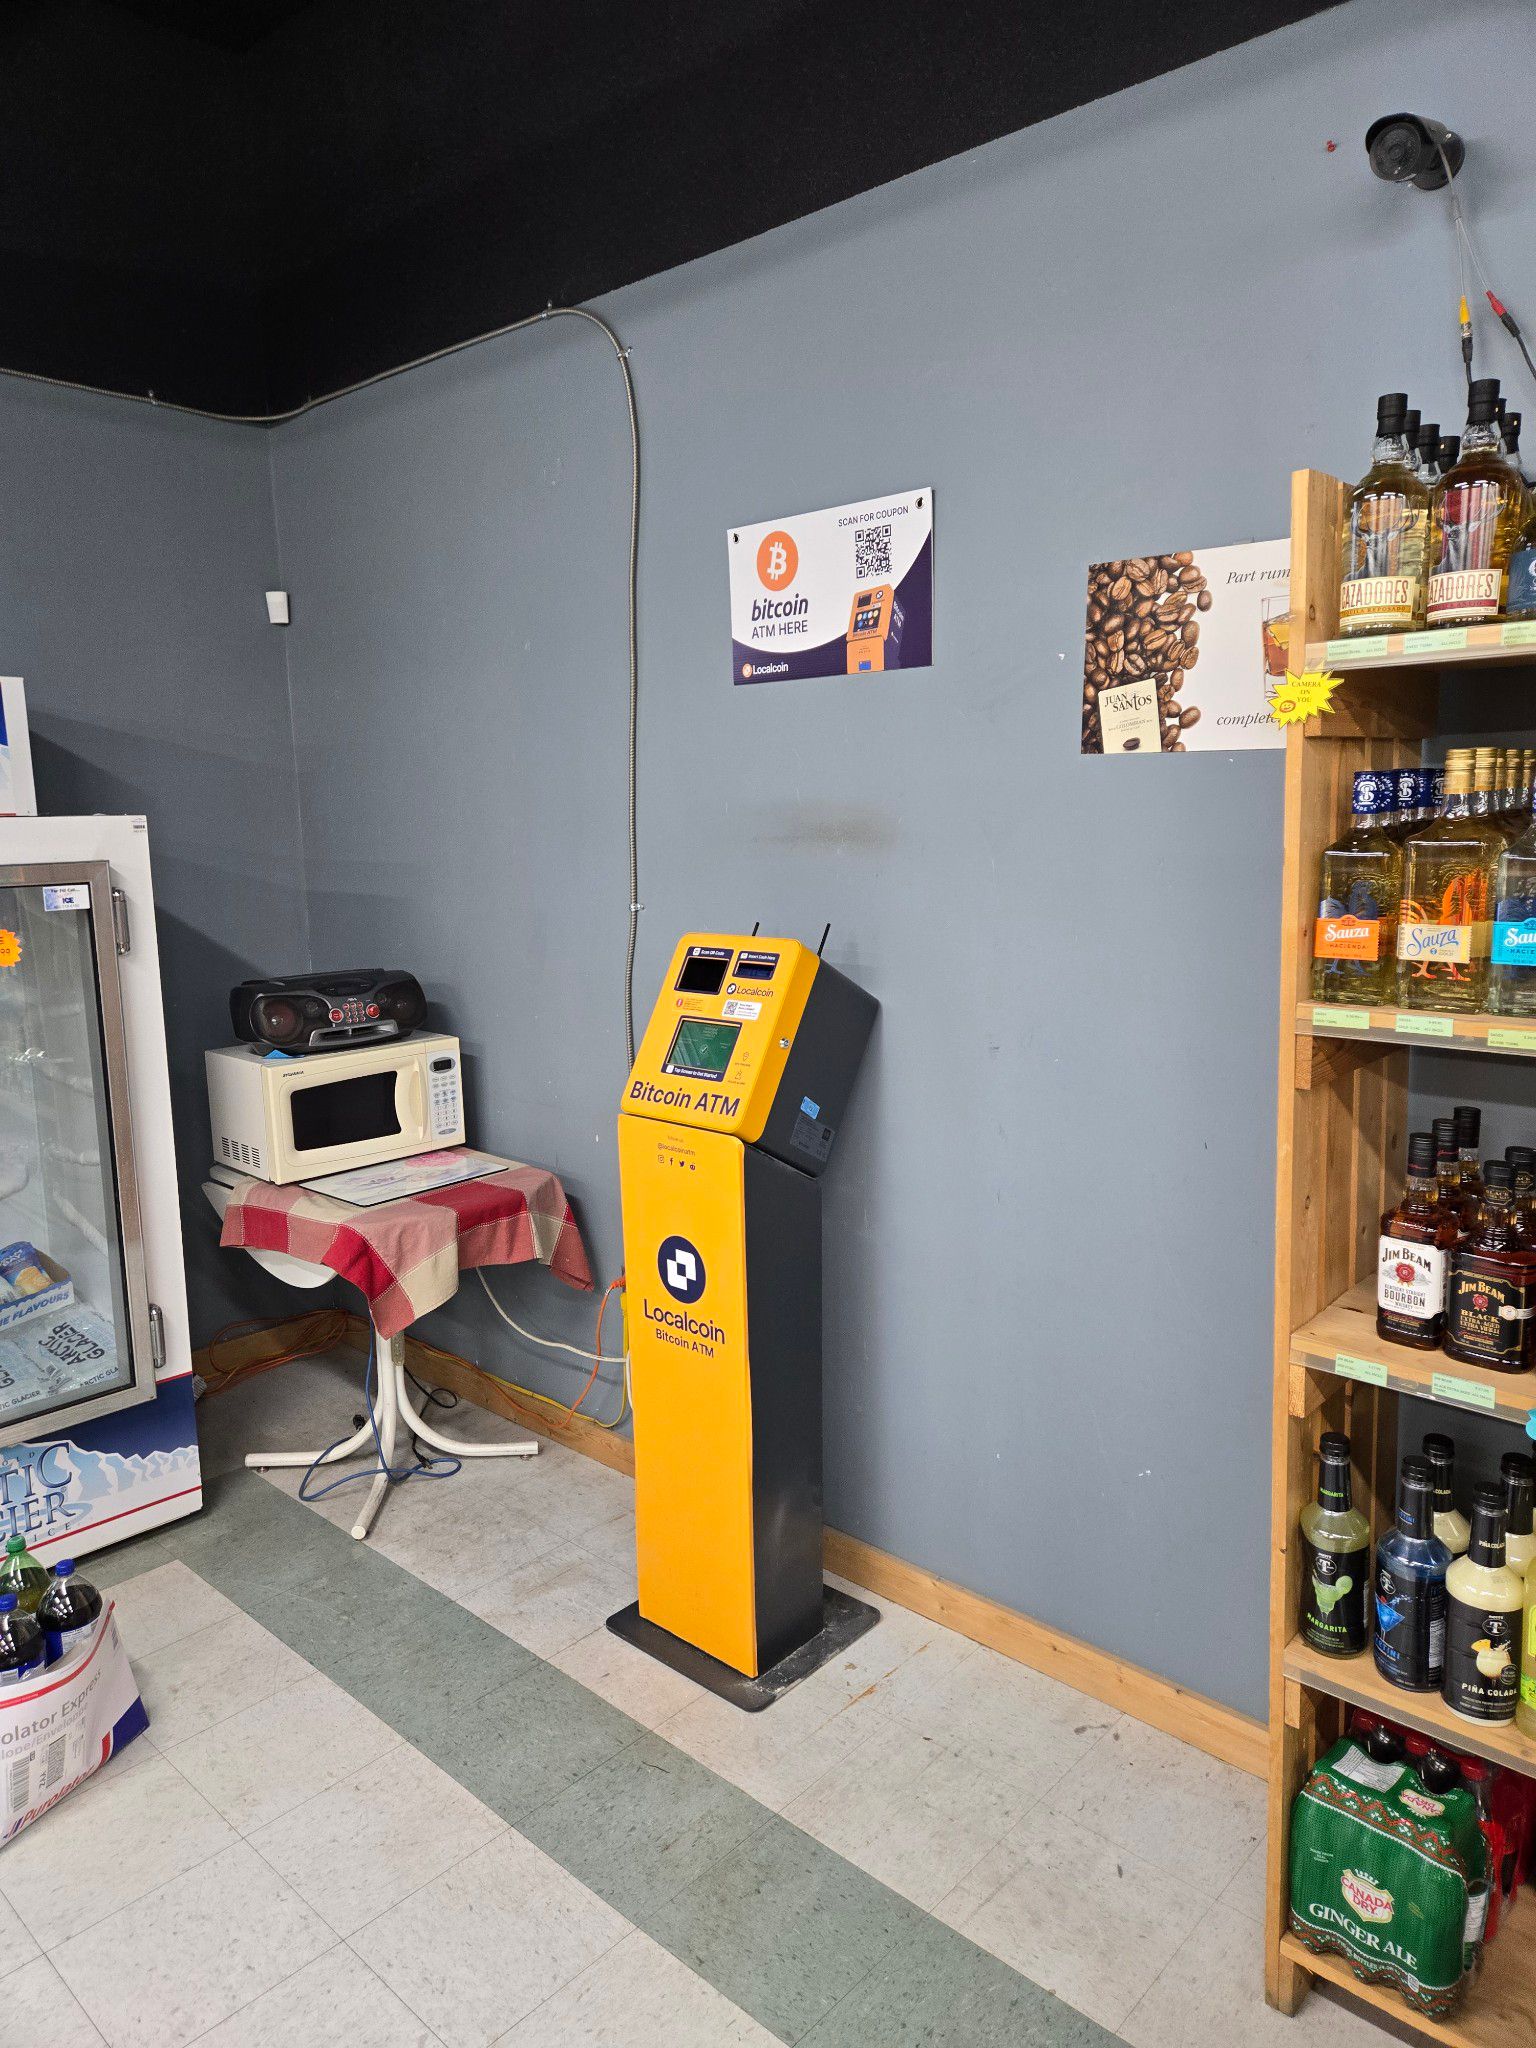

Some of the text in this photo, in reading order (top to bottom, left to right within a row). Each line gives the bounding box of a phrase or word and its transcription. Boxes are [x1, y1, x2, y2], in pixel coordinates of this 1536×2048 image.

[838, 505, 909, 527] SCAN FOR COUPON
[1226, 568, 1291, 585] Part rum
[1428, 573, 1494, 604] AZADORES
[1341, 579, 1409, 610] CAZADORES
[751, 593, 809, 622] bitcoin
[751, 619, 809, 640] ATM HERE
[752, 662, 789, 676] Localcoin
[1104, 693, 1128, 708] JUAN
[62, 896, 75, 904] ICE
[1325, 923, 1370, 942] Sauza
[1406, 927, 1460, 957] Sauza
[736, 985, 774, 998] Localcoin
[630, 1080, 741, 1117] Bitcoin ATM
[1382, 1247, 1432, 1273] JIM BEAM
[1384, 1289, 1426, 1308] BOURBON
[1458, 1280, 1506, 1304] JIM BEAM
[12, 1291, 70, 1321] FLAVOURS
[1461, 1309, 1500, 1324] BLACK
[643, 1298, 726, 1345] Localcoin
[38, 1338, 87, 1366] ARCTIC
[52, 1321, 106, 1360] GLACIER
[656, 1327, 715, 1359] Bitcoin ATM
[11, 1390, 41, 1405] GLACIER
[34, 1521, 72, 1542] ICE
[1306, 1612, 1348, 1633] MARGARITA
[1461, 1682, 1518, 1698] PIÑA COLADA
[1, 1668, 102, 1745] olator Express
[22, 1765, 95, 1829] Purolator
[1341, 1876, 1393, 1913] CANADA
[1352, 1894, 1378, 1915] DRY
[1309, 1903, 1418, 1971] GINGER ALE
